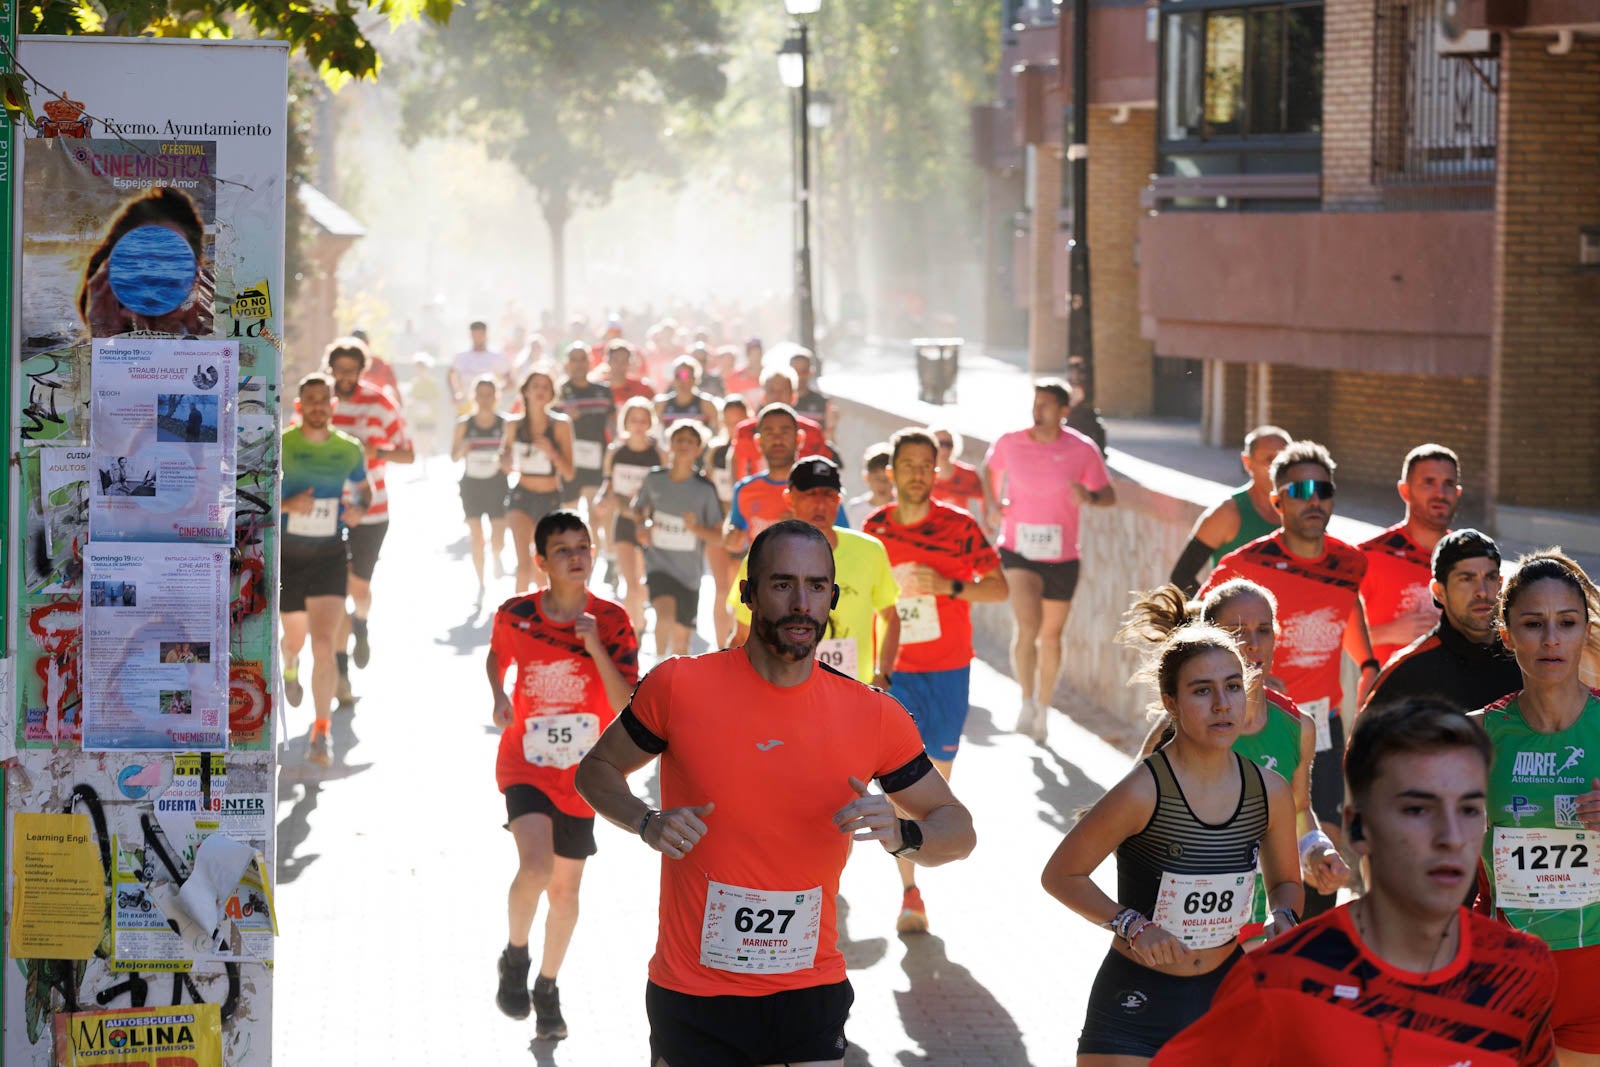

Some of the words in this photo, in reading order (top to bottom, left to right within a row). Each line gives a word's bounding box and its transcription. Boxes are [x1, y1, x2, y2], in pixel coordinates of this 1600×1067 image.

[104, 118, 159, 135] Excmo.
[164, 119, 272, 139] Ayuntamiento
[170, 144, 206, 156] FESTIVAL
[113, 177, 153, 190] Espejos
[155, 178, 168, 188] de
[170, 178, 199, 189] Amor
[252, 297, 266, 306] NO
[237, 306, 266, 316] VOTO
[99, 348, 131, 357] Domingo
[49, 464, 87, 472] ADULTOS
[178, 526, 228, 538] CINEMISTICA
[90, 554, 123, 563] Domingo
[172, 732, 221, 744] CINEMISTICA
[547, 727, 572, 744] 55
[1512, 751, 1557, 776] ATARFE
[187, 778, 197, 787] de
[1511, 775, 1555, 784] Atletismo
[1556, 775, 1585, 784] Atarfe
[158, 799, 196, 811] OFERTA
[26, 833, 64, 843] Learning
[1511, 844, 1589, 870] 1272
[1535, 872, 1571, 883] VIRGINIA
[1183, 890, 1235, 914] 698
[734, 907, 796, 935] 627
[1182, 918, 1208, 926] NOELIA
[742, 937, 788, 948] MARINETTO
[115, 961, 179, 970] Mejoramos
[105, 1014, 194, 1028] AUTOESCUELAS
[78, 1019, 194, 1050] MOLINA
[79, 1049, 115, 1057] TODOS
[141, 1043, 196, 1053] PERMISOS
